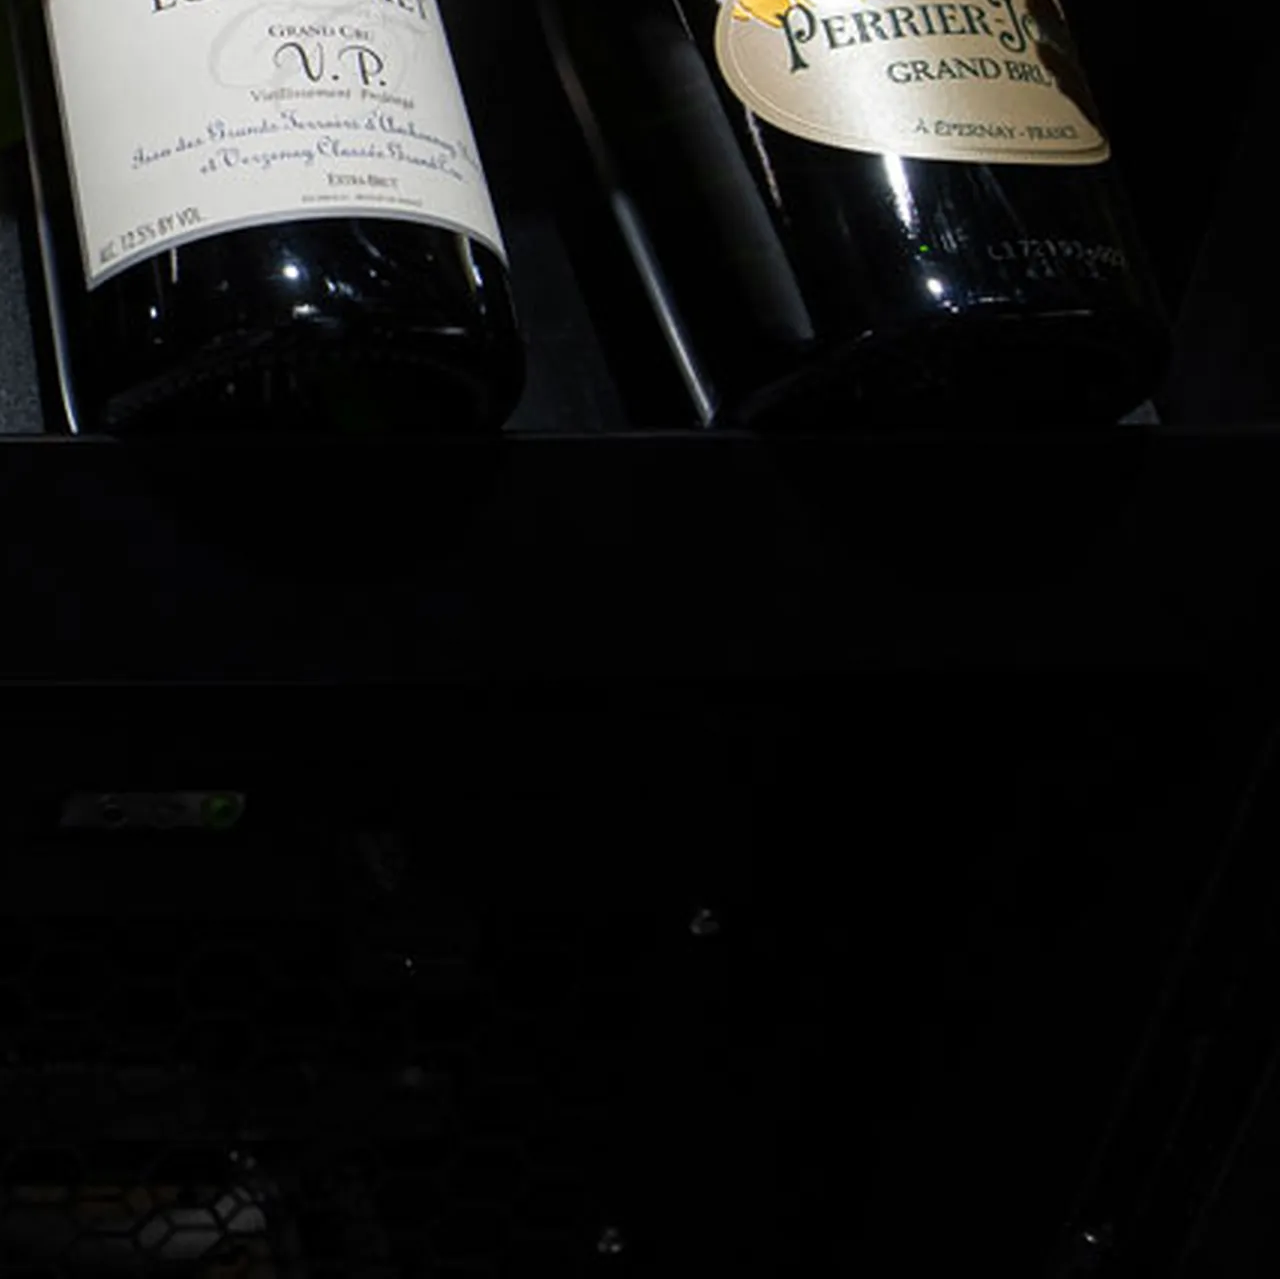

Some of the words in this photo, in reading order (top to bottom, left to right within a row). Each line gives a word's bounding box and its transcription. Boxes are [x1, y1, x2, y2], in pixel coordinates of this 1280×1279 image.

[267, 24, 335, 39] GRAND
[887, 56, 1003, 84] GRAND
[1002, 59, 1055, 88] BRU
